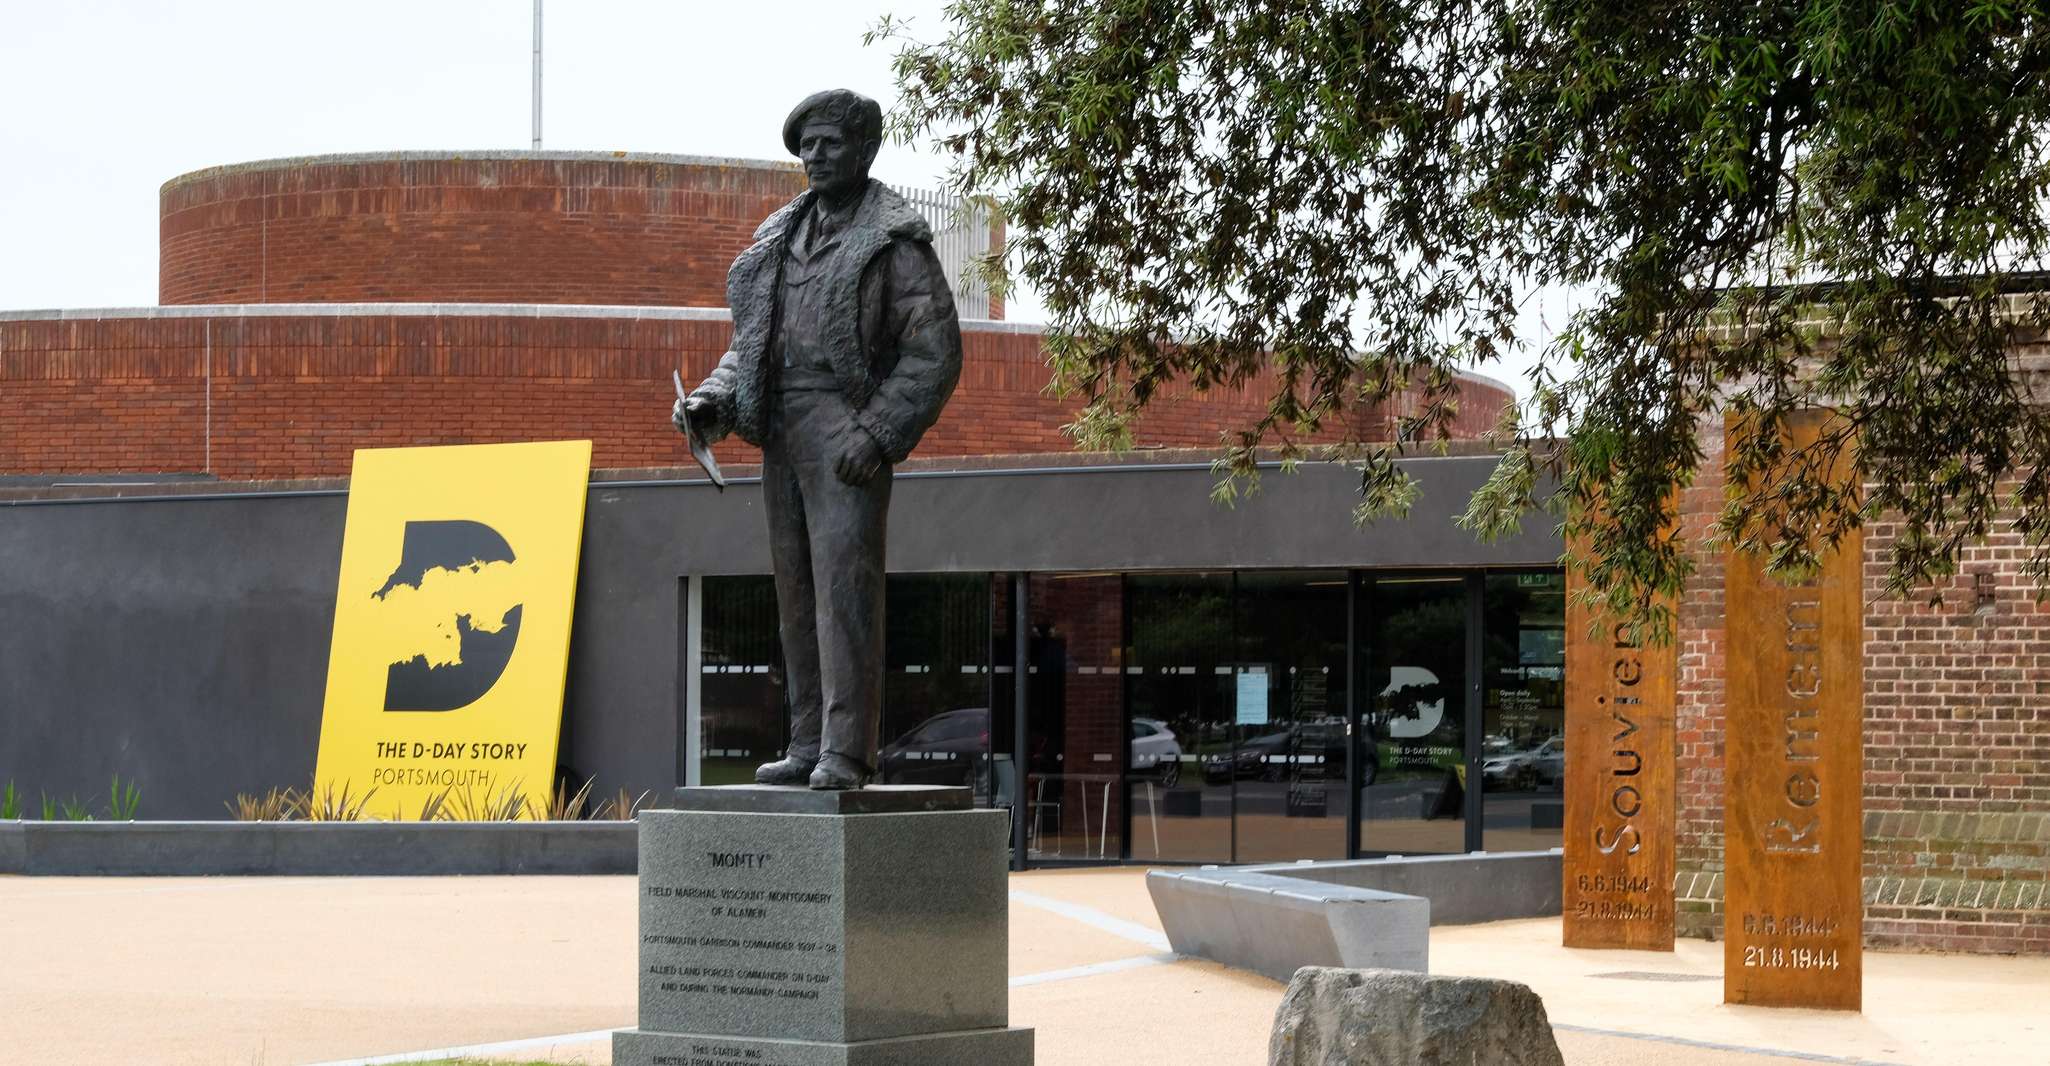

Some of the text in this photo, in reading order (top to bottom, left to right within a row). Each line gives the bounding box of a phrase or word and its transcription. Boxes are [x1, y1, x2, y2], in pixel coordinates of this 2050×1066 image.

[1763, 601, 1821, 855] Remem
[1595, 622, 1643, 856] Souvien
[376, 742, 527, 760] THE D-DAY STORY
[1390, 746, 1453, 755] THE D-DAY STORY
[1389, 756, 1439, 765] PORTSMOUTH
[373, 768, 489, 787] PORTSMOUTH
[648, 887, 832, 904] FIELD MARSHAL VISCOUNT MONTGOMERY
[712, 906, 767, 919] OF ALAMEIN
[643, 935, 697, 946] PORTSMOUTH
[699, 937, 740, 948] GARRISON
[742, 940, 793, 951] COMMANDER
[1743, 945, 1840, 970] 21.8.1944
[650, 965, 830, 983] ALLIED LAND FORCES COMMANDER ON D-DAY
[661, 982, 819, 1000] AND DURING THE NORMANDY CAMPAIGN
[692, 1045, 761, 1060] THIS STATUE WAS
